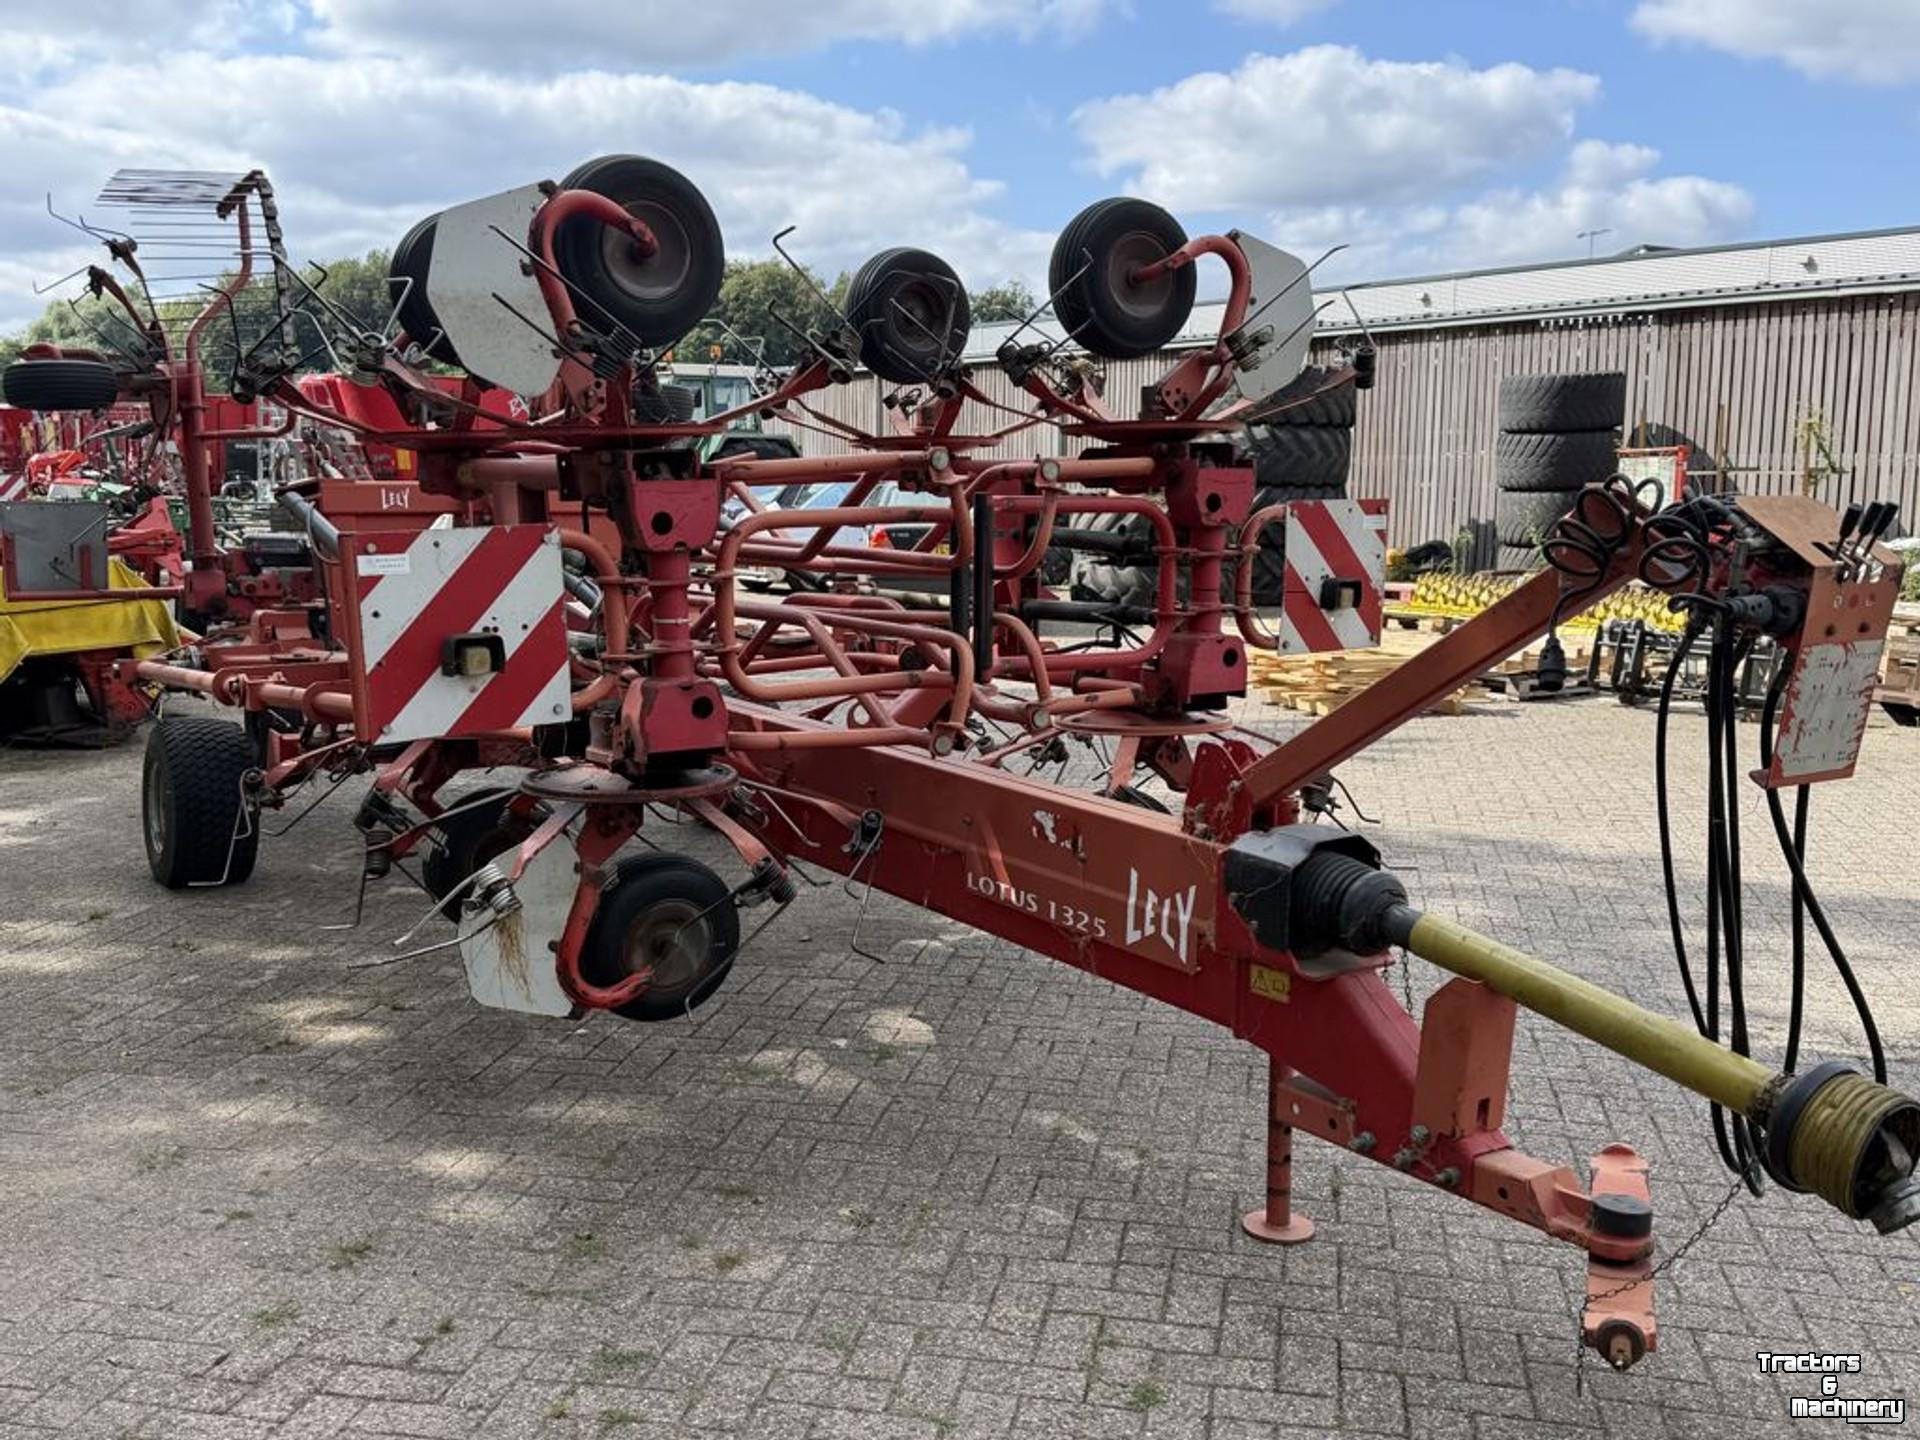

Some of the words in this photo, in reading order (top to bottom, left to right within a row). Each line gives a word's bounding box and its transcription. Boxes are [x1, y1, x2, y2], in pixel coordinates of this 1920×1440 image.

[381, 487, 410, 510] LELY
[967, 871, 1038, 913] LOTUS
[1048, 900, 1106, 937] 1325
[1126, 866, 1197, 965] LELY
